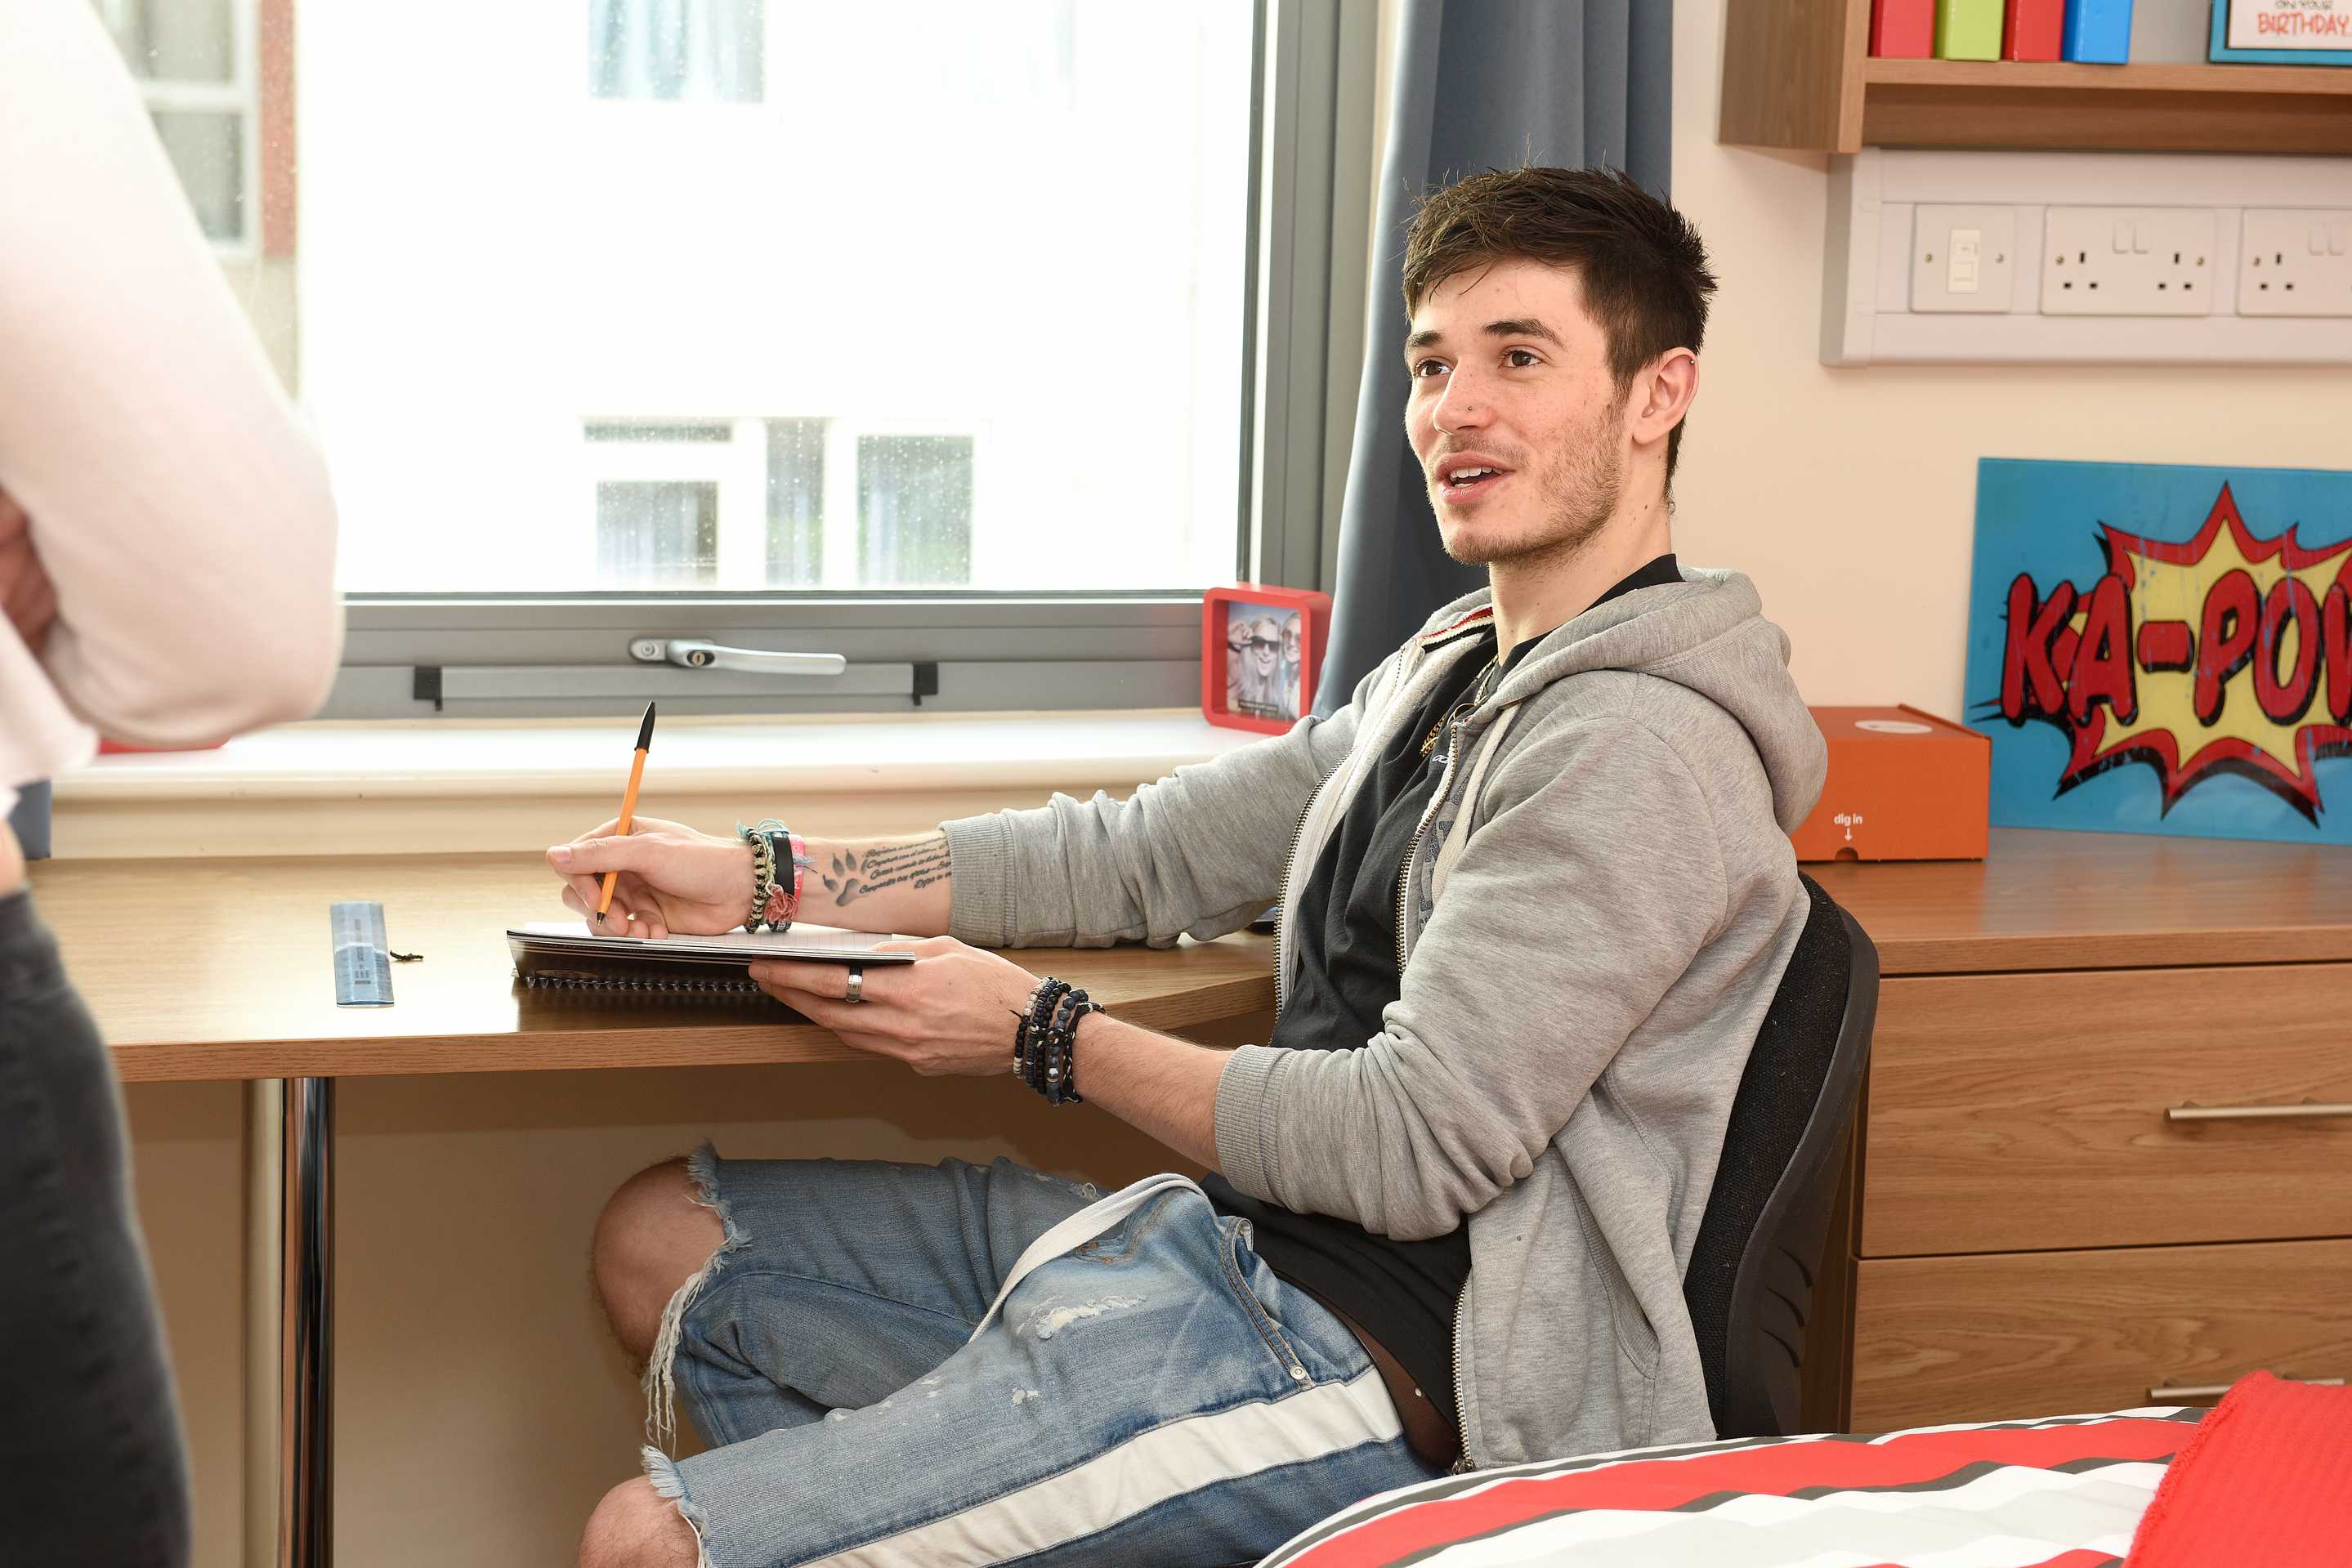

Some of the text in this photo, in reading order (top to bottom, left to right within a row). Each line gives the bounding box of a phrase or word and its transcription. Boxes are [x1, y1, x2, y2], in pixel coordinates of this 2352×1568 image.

[2258, 12, 2350, 37] BIRTHDAY
[1833, 812, 1862, 827] dig in
